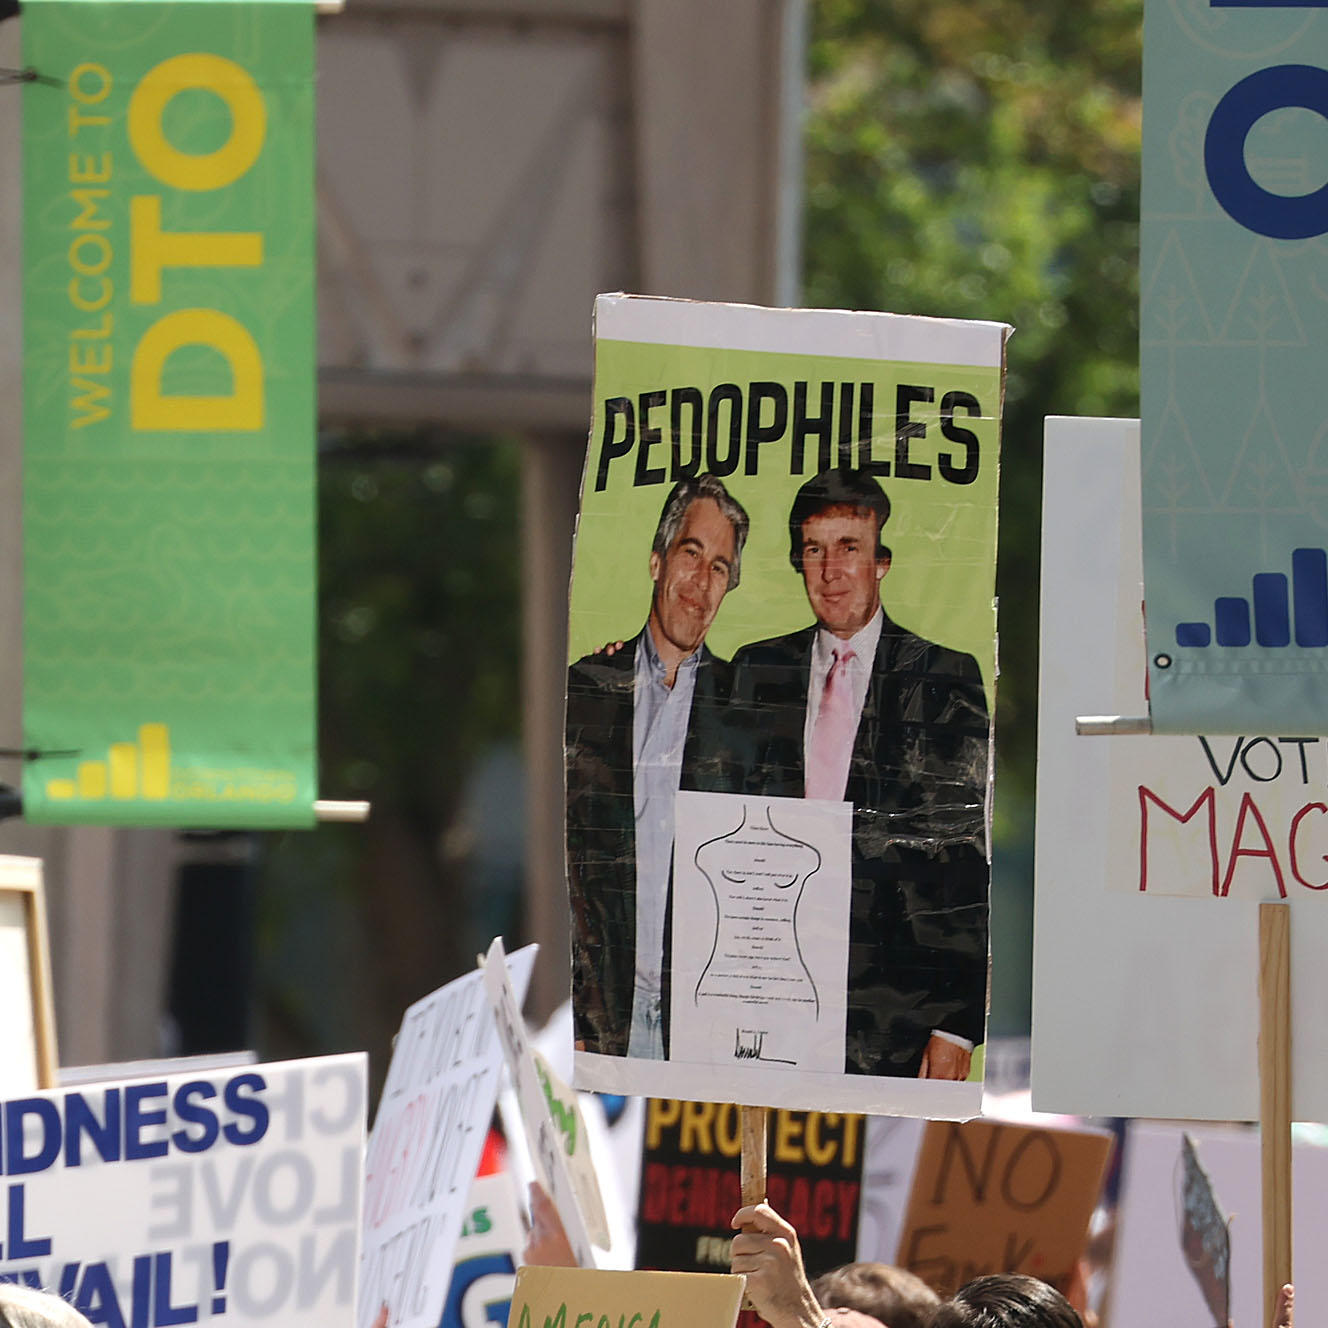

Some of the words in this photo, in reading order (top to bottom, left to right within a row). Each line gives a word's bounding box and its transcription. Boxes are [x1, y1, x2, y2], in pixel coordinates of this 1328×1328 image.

[68, 62, 112, 138] TO
[128, 53, 266, 431] DTO
[68, 160, 112, 430] WELCOME
[595, 380, 982, 491] PEDOPHILES
[647, 1097, 868, 1168] PROECT
[933, 1122, 1062, 1211] NO
